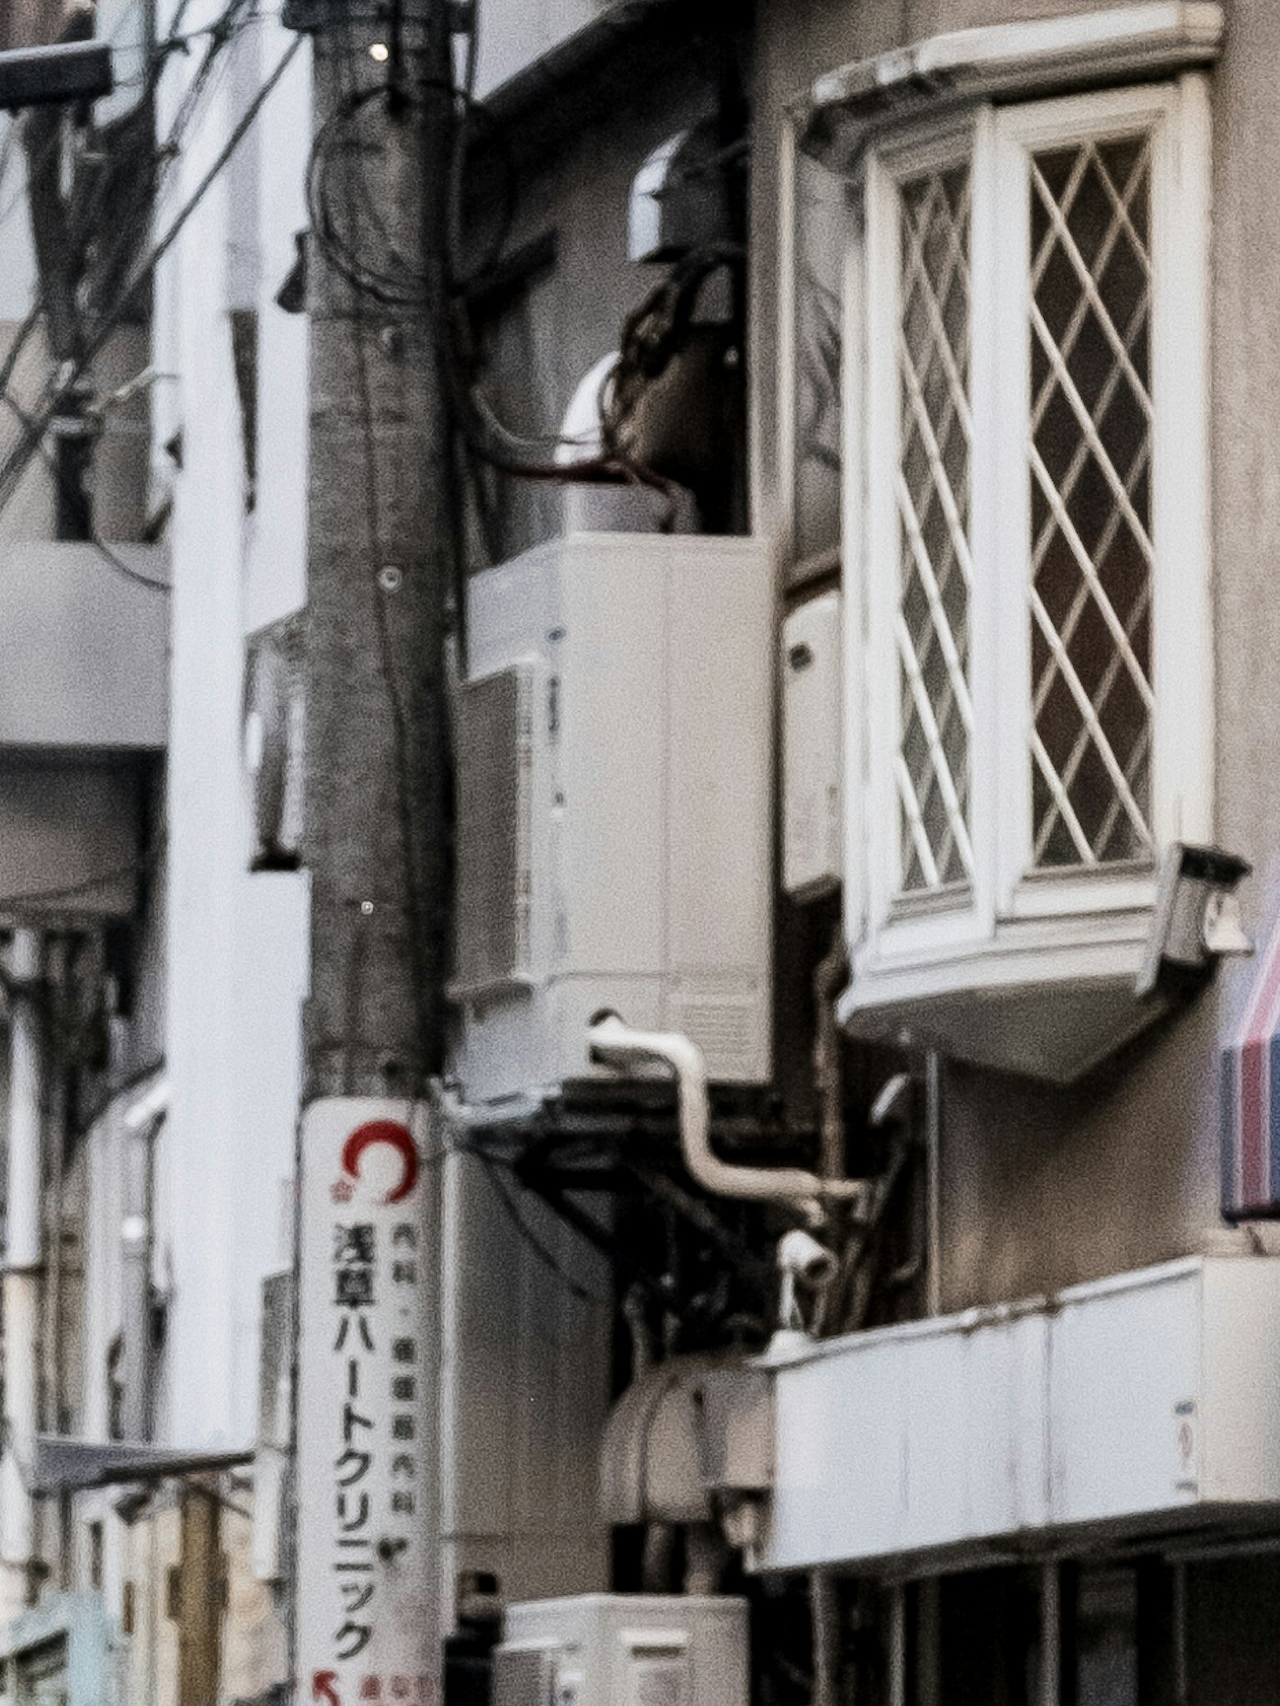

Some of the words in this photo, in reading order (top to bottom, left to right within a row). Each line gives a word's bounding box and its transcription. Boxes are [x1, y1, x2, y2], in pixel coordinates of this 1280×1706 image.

[331, 1222, 376, 1660] 浅草ハートクリニック
